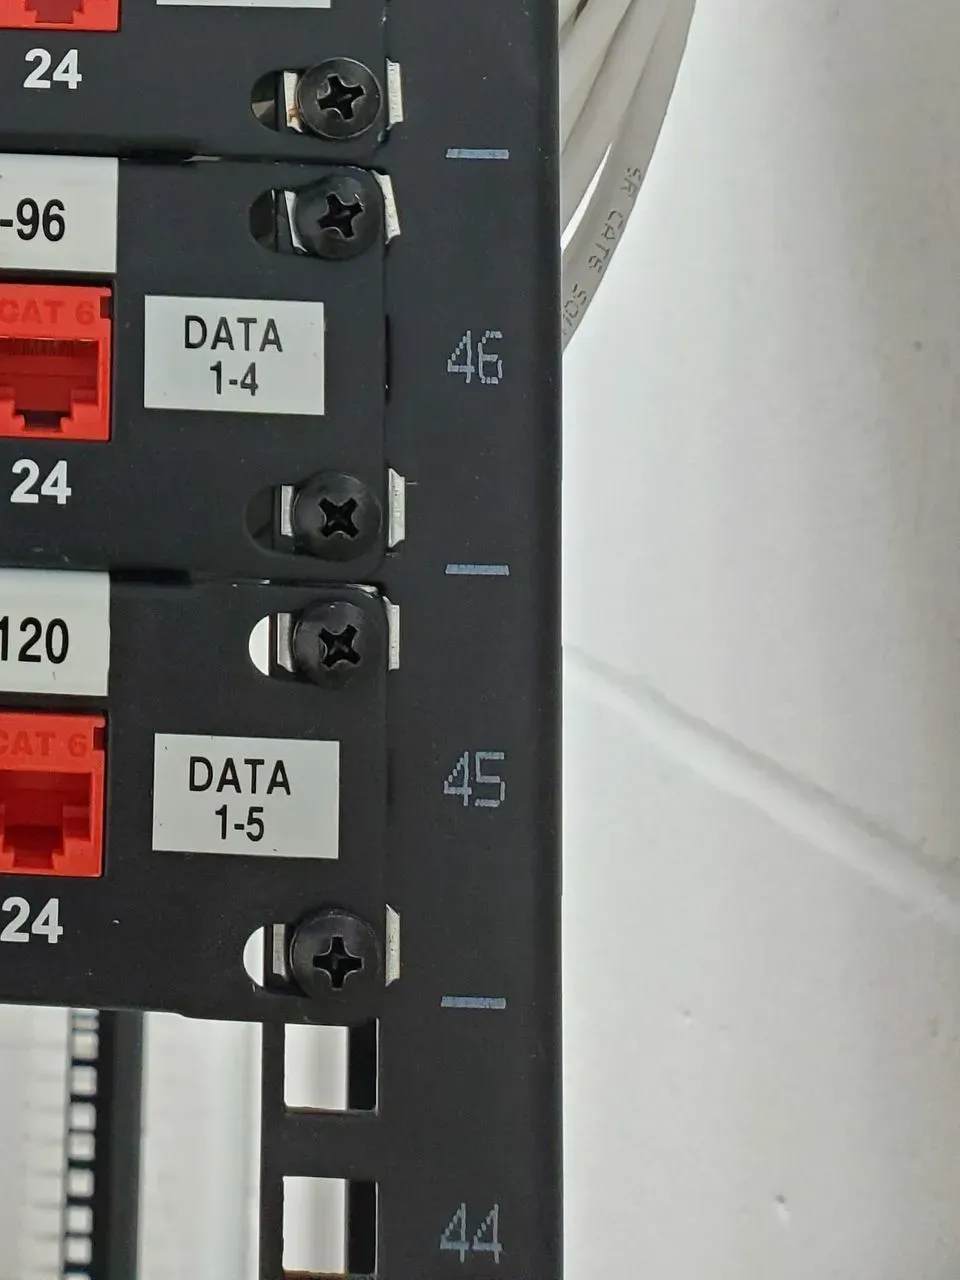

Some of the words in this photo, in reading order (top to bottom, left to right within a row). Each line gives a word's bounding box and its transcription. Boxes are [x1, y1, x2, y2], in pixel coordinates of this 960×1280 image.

[23, 48, 83, 90] 24
[74, 301, 94, 326] 6
[184, 315, 283, 353] DATA
[447, 330, 503, 385] 46
[209, 360, 259, 397] 1-4
[10, 458, 72, 505] 24
[66, 733, 86, 758] 6
[189, 755, 291, 796] DATA
[443, 751, 506, 808] 45
[214, 804, 265, 842] 1-5
[0, 896, 64, 944] 24
[439, 1202, 503, 1265] 44
